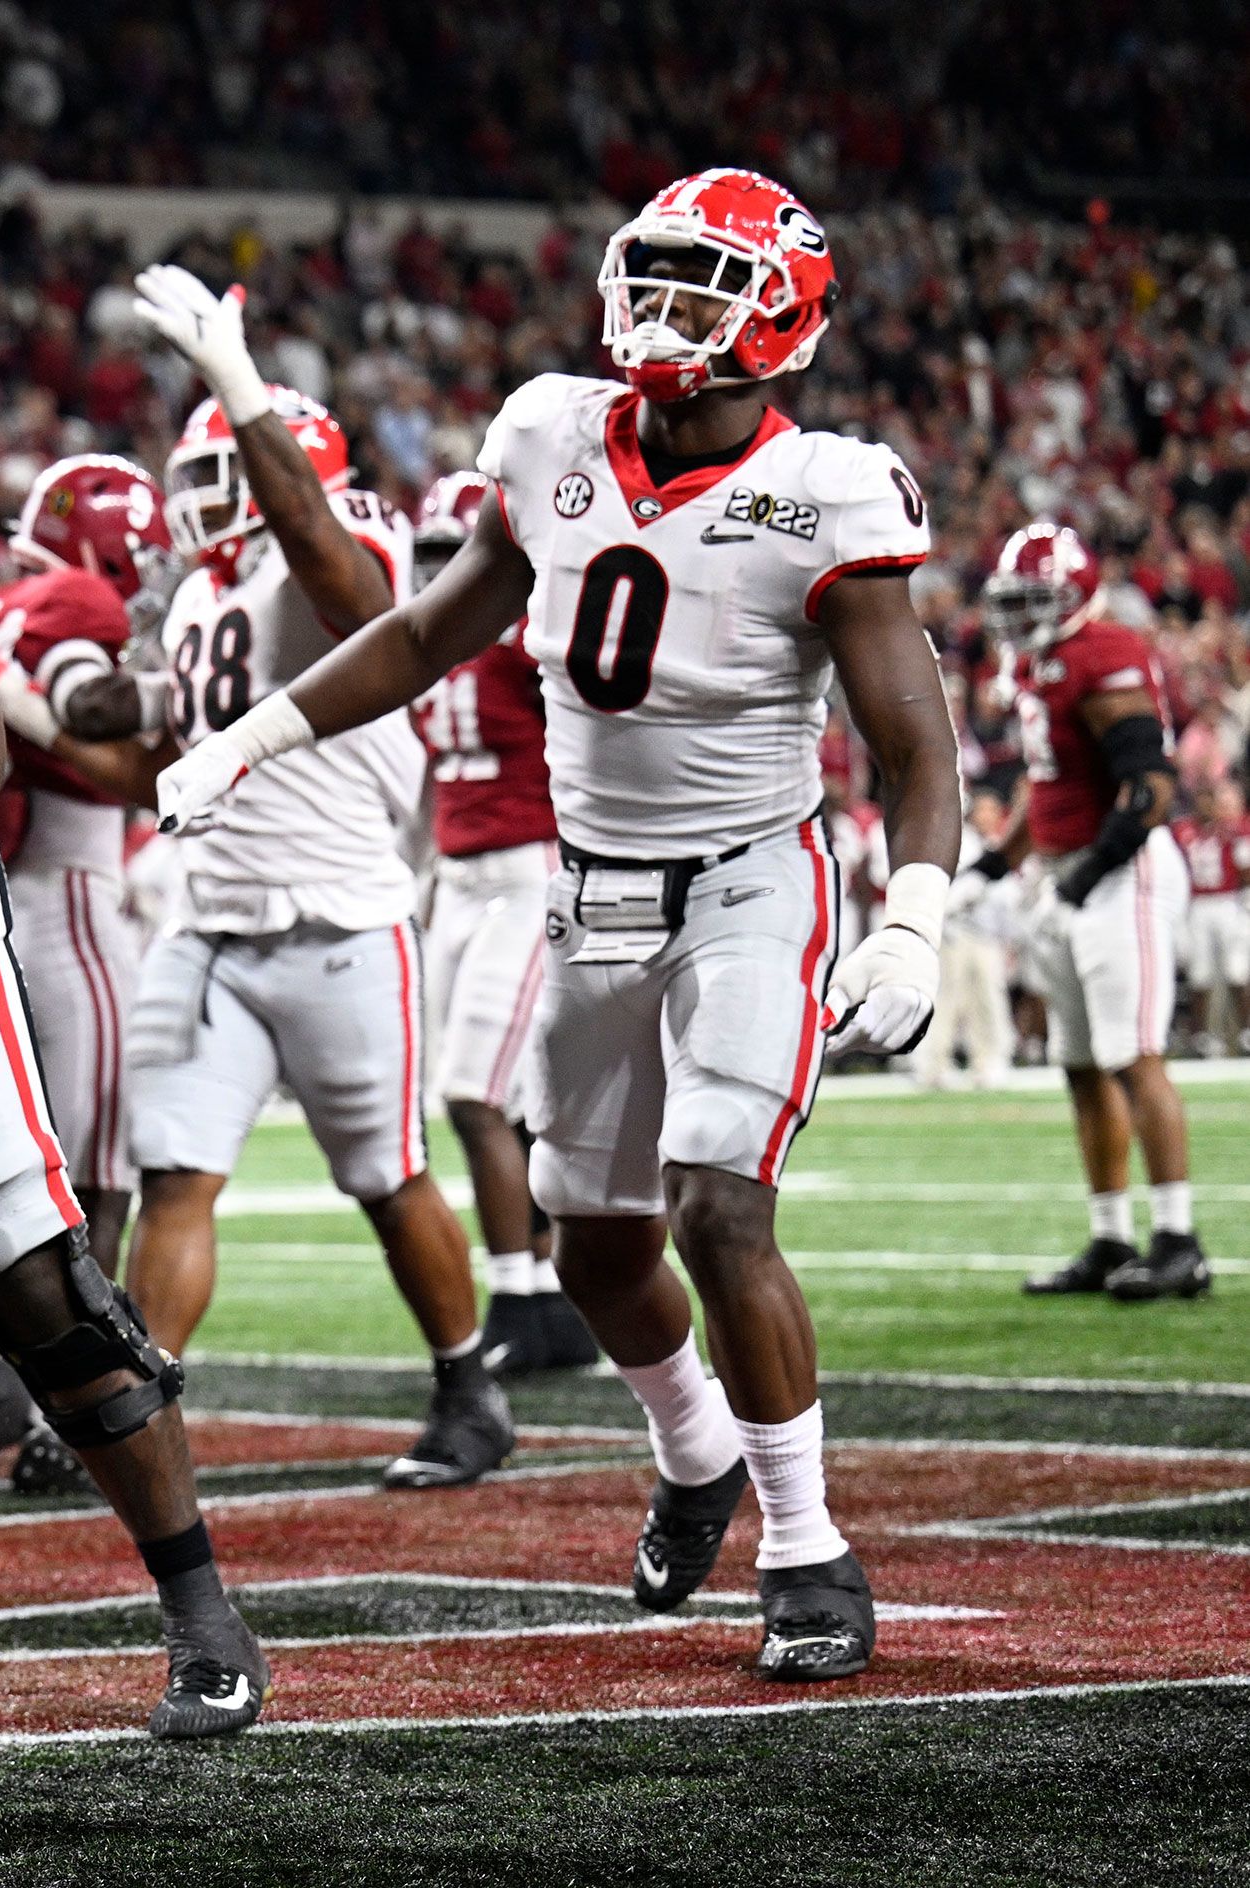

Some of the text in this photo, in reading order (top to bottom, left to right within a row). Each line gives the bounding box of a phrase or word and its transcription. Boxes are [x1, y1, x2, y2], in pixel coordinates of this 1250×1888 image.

[554, 473, 592, 517] SEC
[634, 498, 661, 518] G
[724, 486, 821, 541] 2022
[889, 466, 924, 528] 0
[565, 543, 669, 713] 0
[173, 606, 253, 742] 88
